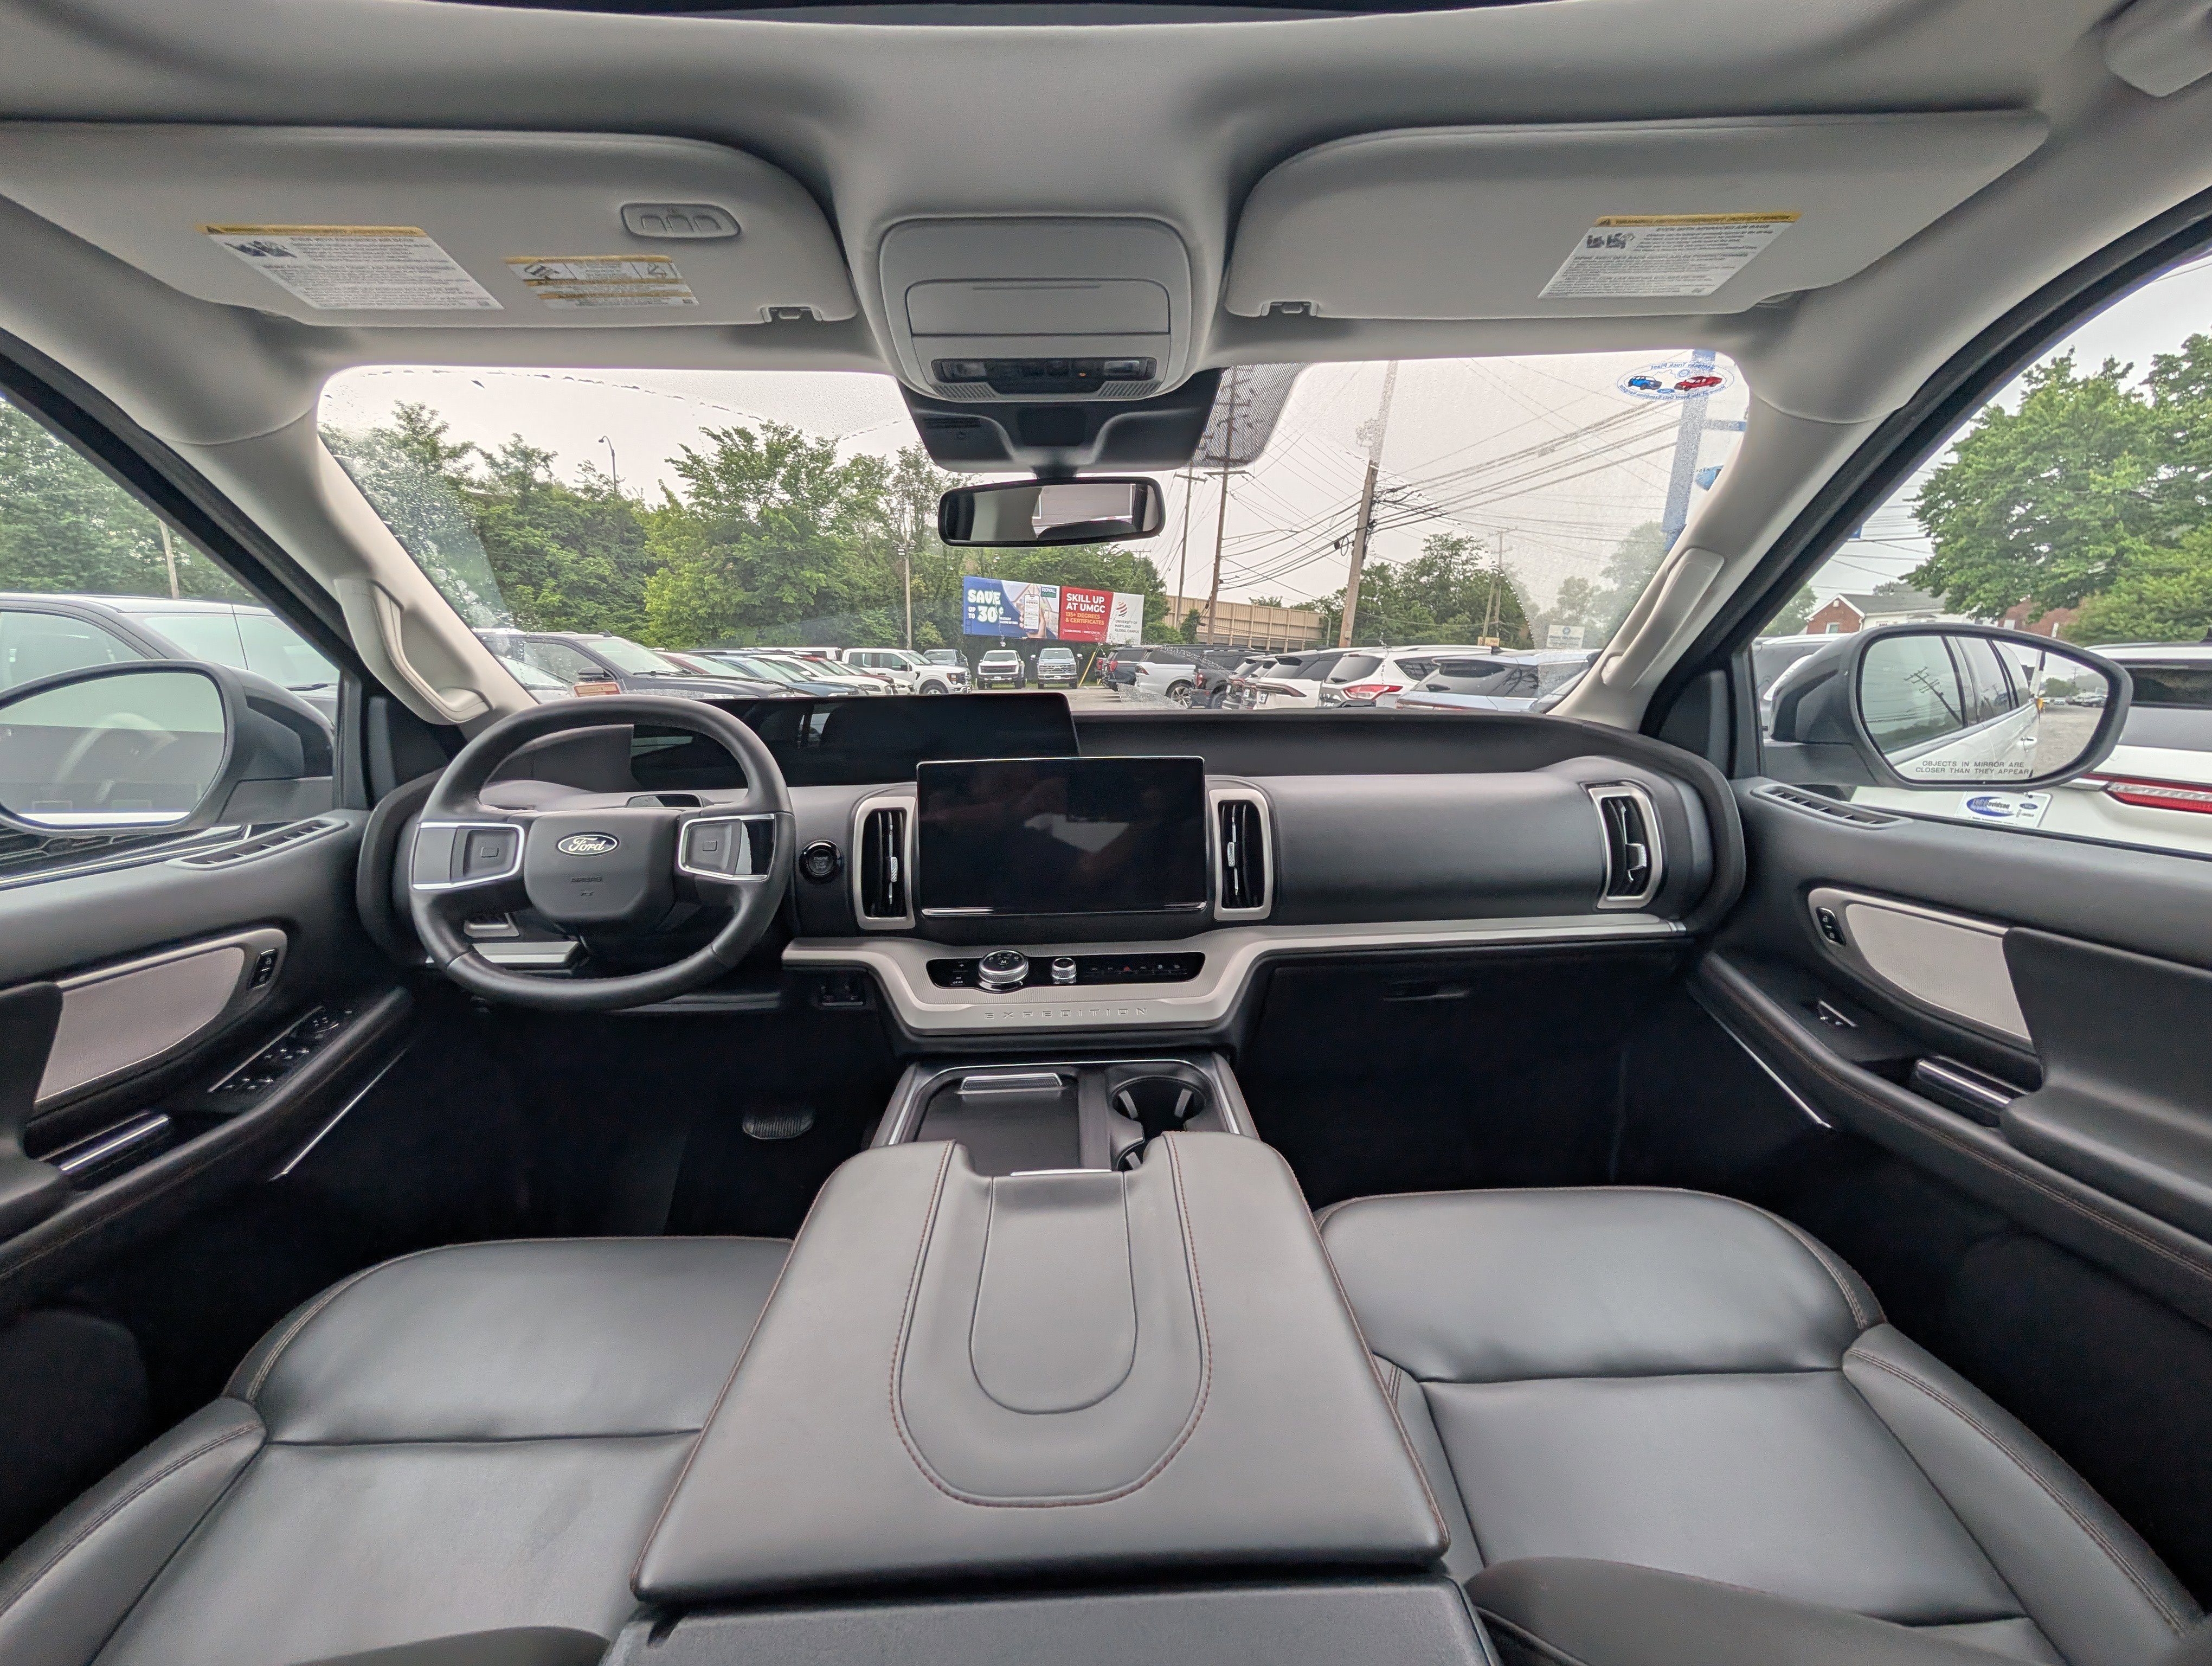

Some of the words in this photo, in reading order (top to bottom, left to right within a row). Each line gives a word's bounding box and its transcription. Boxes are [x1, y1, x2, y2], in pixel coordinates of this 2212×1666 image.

[968, 589, 1001, 605] SAVE
[1066, 593, 1091, 603] SKILL
[1092, 595, 1105, 604] UP
[1066, 602, 1078, 611] AT
[1080, 603, 1105, 613] UMGC
[568, 837, 607, 851] Ford
[984, 1008, 1147, 1019] EXPEDITION
